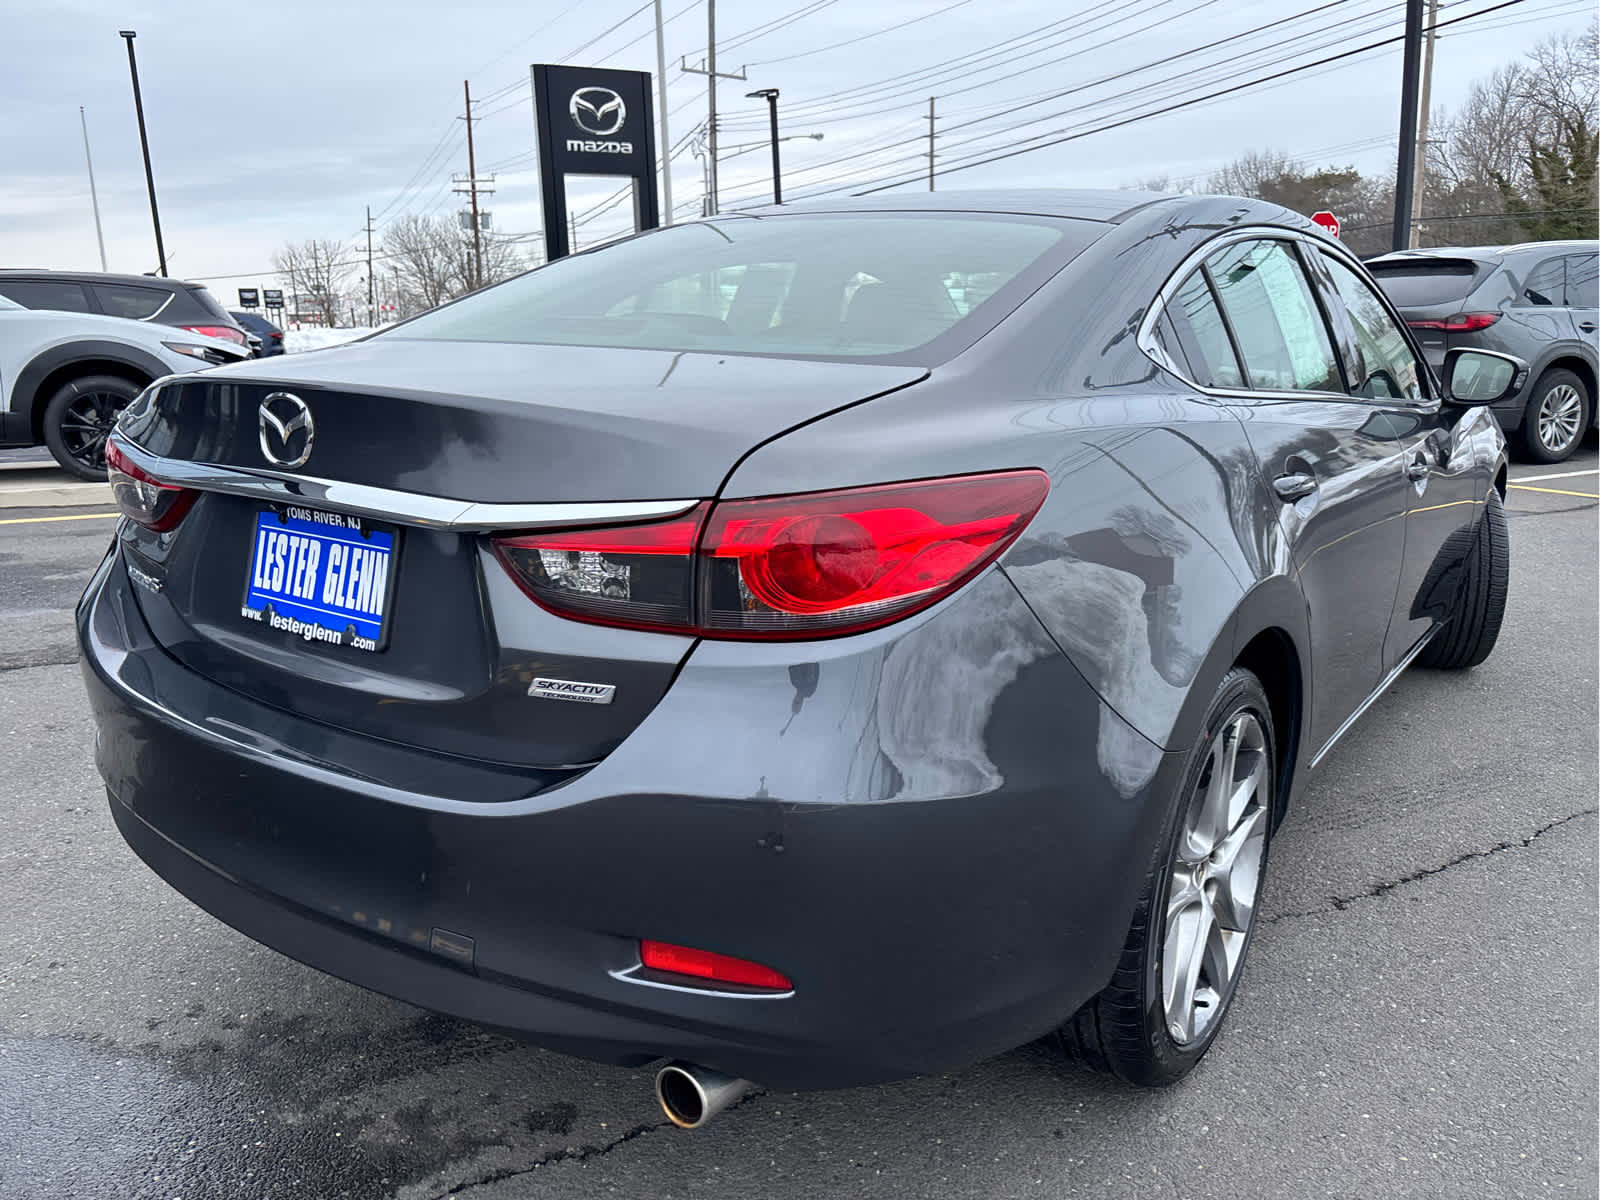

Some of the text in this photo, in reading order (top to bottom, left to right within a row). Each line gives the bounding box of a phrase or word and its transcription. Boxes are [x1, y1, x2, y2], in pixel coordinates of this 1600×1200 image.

[313, 511, 346, 528] RIVER,
[347, 516, 361, 530] NJ
[253, 530, 390, 616] LESTER GLENN
[536, 680, 606, 694] SKYACTIV
